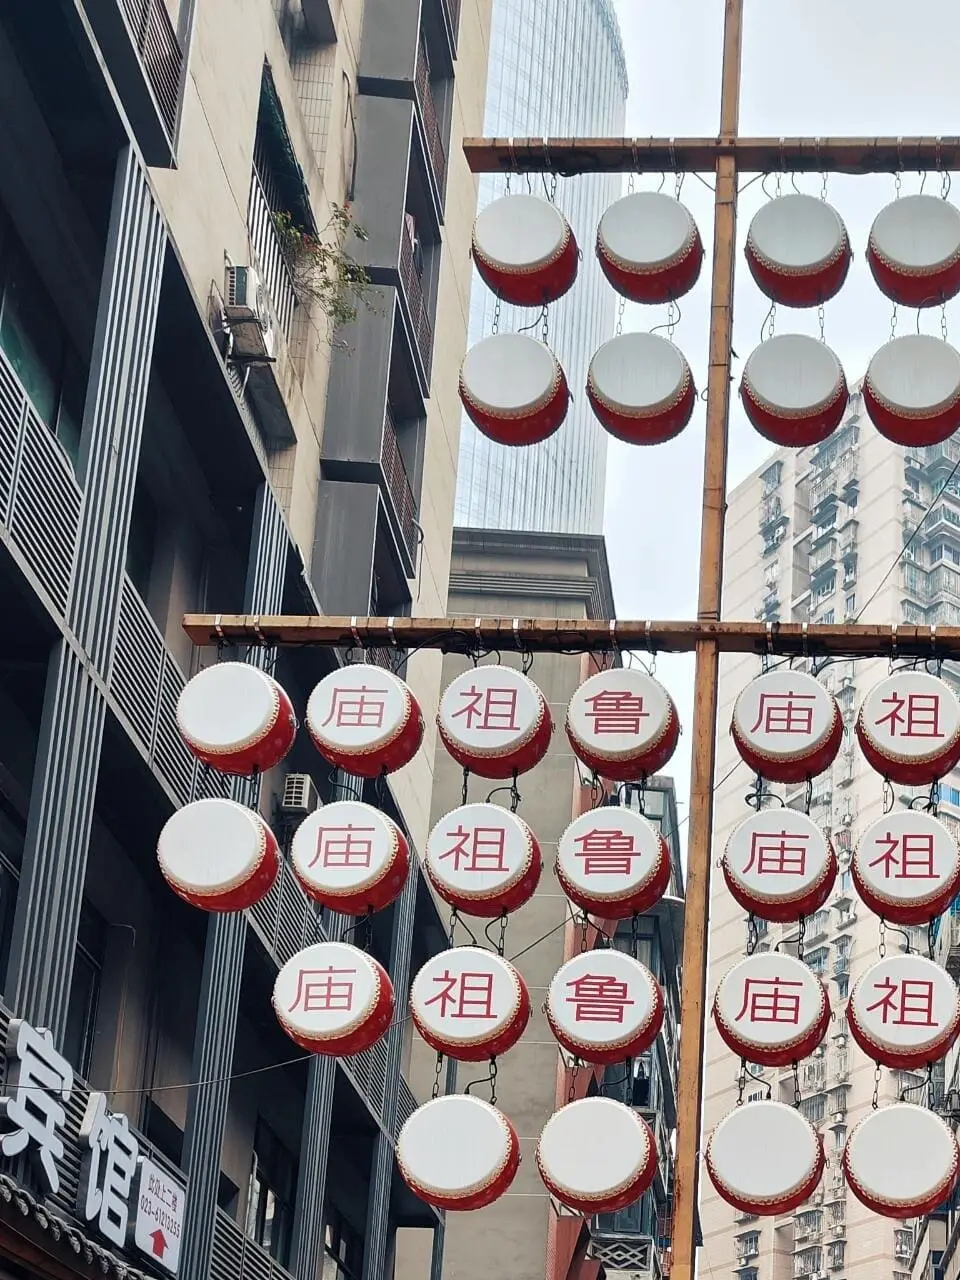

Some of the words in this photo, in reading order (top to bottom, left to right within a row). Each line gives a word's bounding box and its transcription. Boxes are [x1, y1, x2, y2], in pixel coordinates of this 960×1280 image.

[322, 685, 388, 728] 庙
[451, 685, 520, 730] 祖
[584, 690, 650, 735] 鲁
[751, 691, 816, 735] 庙
[875, 691, 945, 738] 祖
[308, 824, 376, 869] 庙
[438, 825, 510, 872] 祖
[574, 829, 641, 875] 鲁
[742, 830, 809, 875] 庙
[868, 832, 940, 879] 祖
[288, 966, 356, 1013] 庙
[424, 970, 498, 1018] 祖
[565, 973, 634, 1023] 鲁
[735, 976, 803, 1025] 庙
[867, 977, 939, 1026] 祖
[2, 1019, 139, 1248] 宾馆
